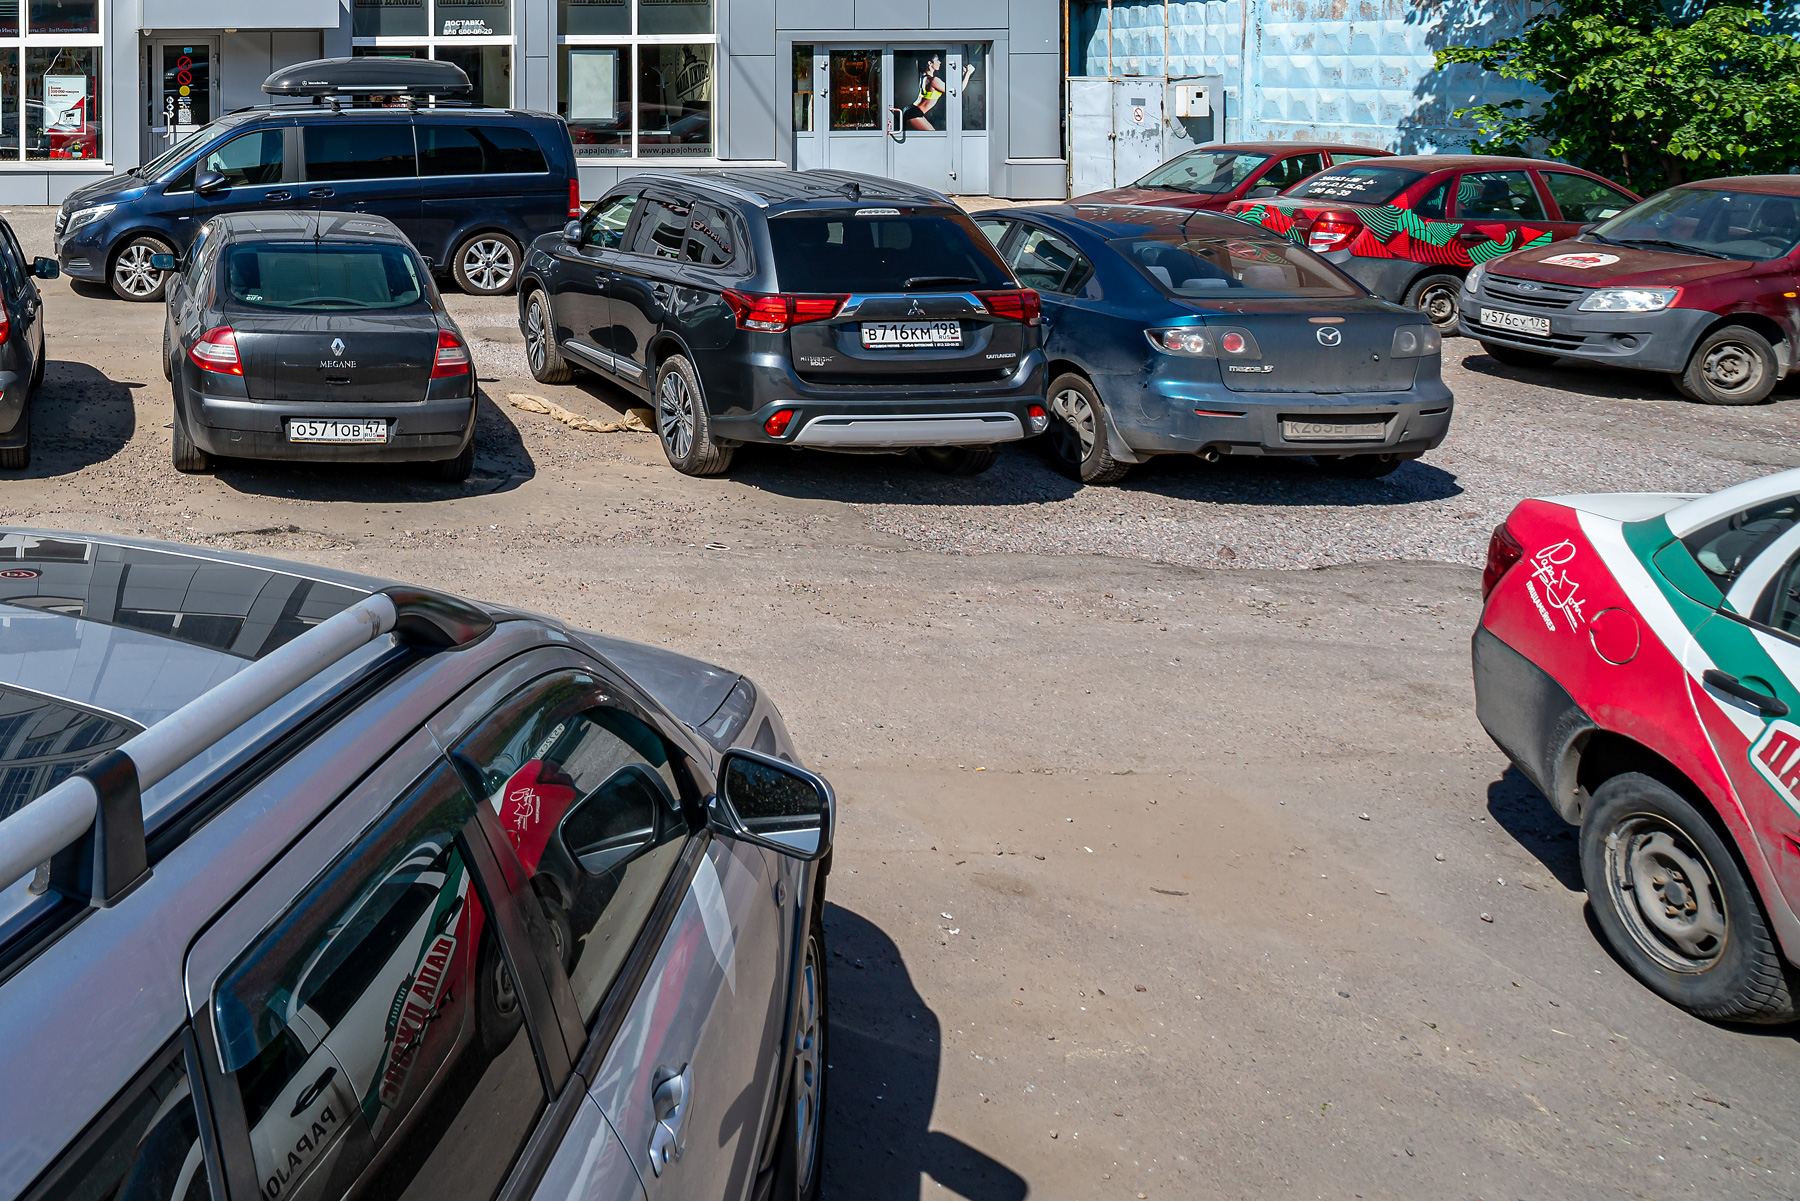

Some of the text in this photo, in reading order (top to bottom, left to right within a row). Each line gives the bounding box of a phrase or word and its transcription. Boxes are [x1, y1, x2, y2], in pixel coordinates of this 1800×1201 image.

[639, 146, 712, 156] www.papajohns.ru
[933, 323, 955, 335] 198
[319, 360, 357, 368] MEGANE
[365, 421, 381, 433] 47
[1526, 580, 1556, 632] ПИЦЦАМЕЙКЕР
